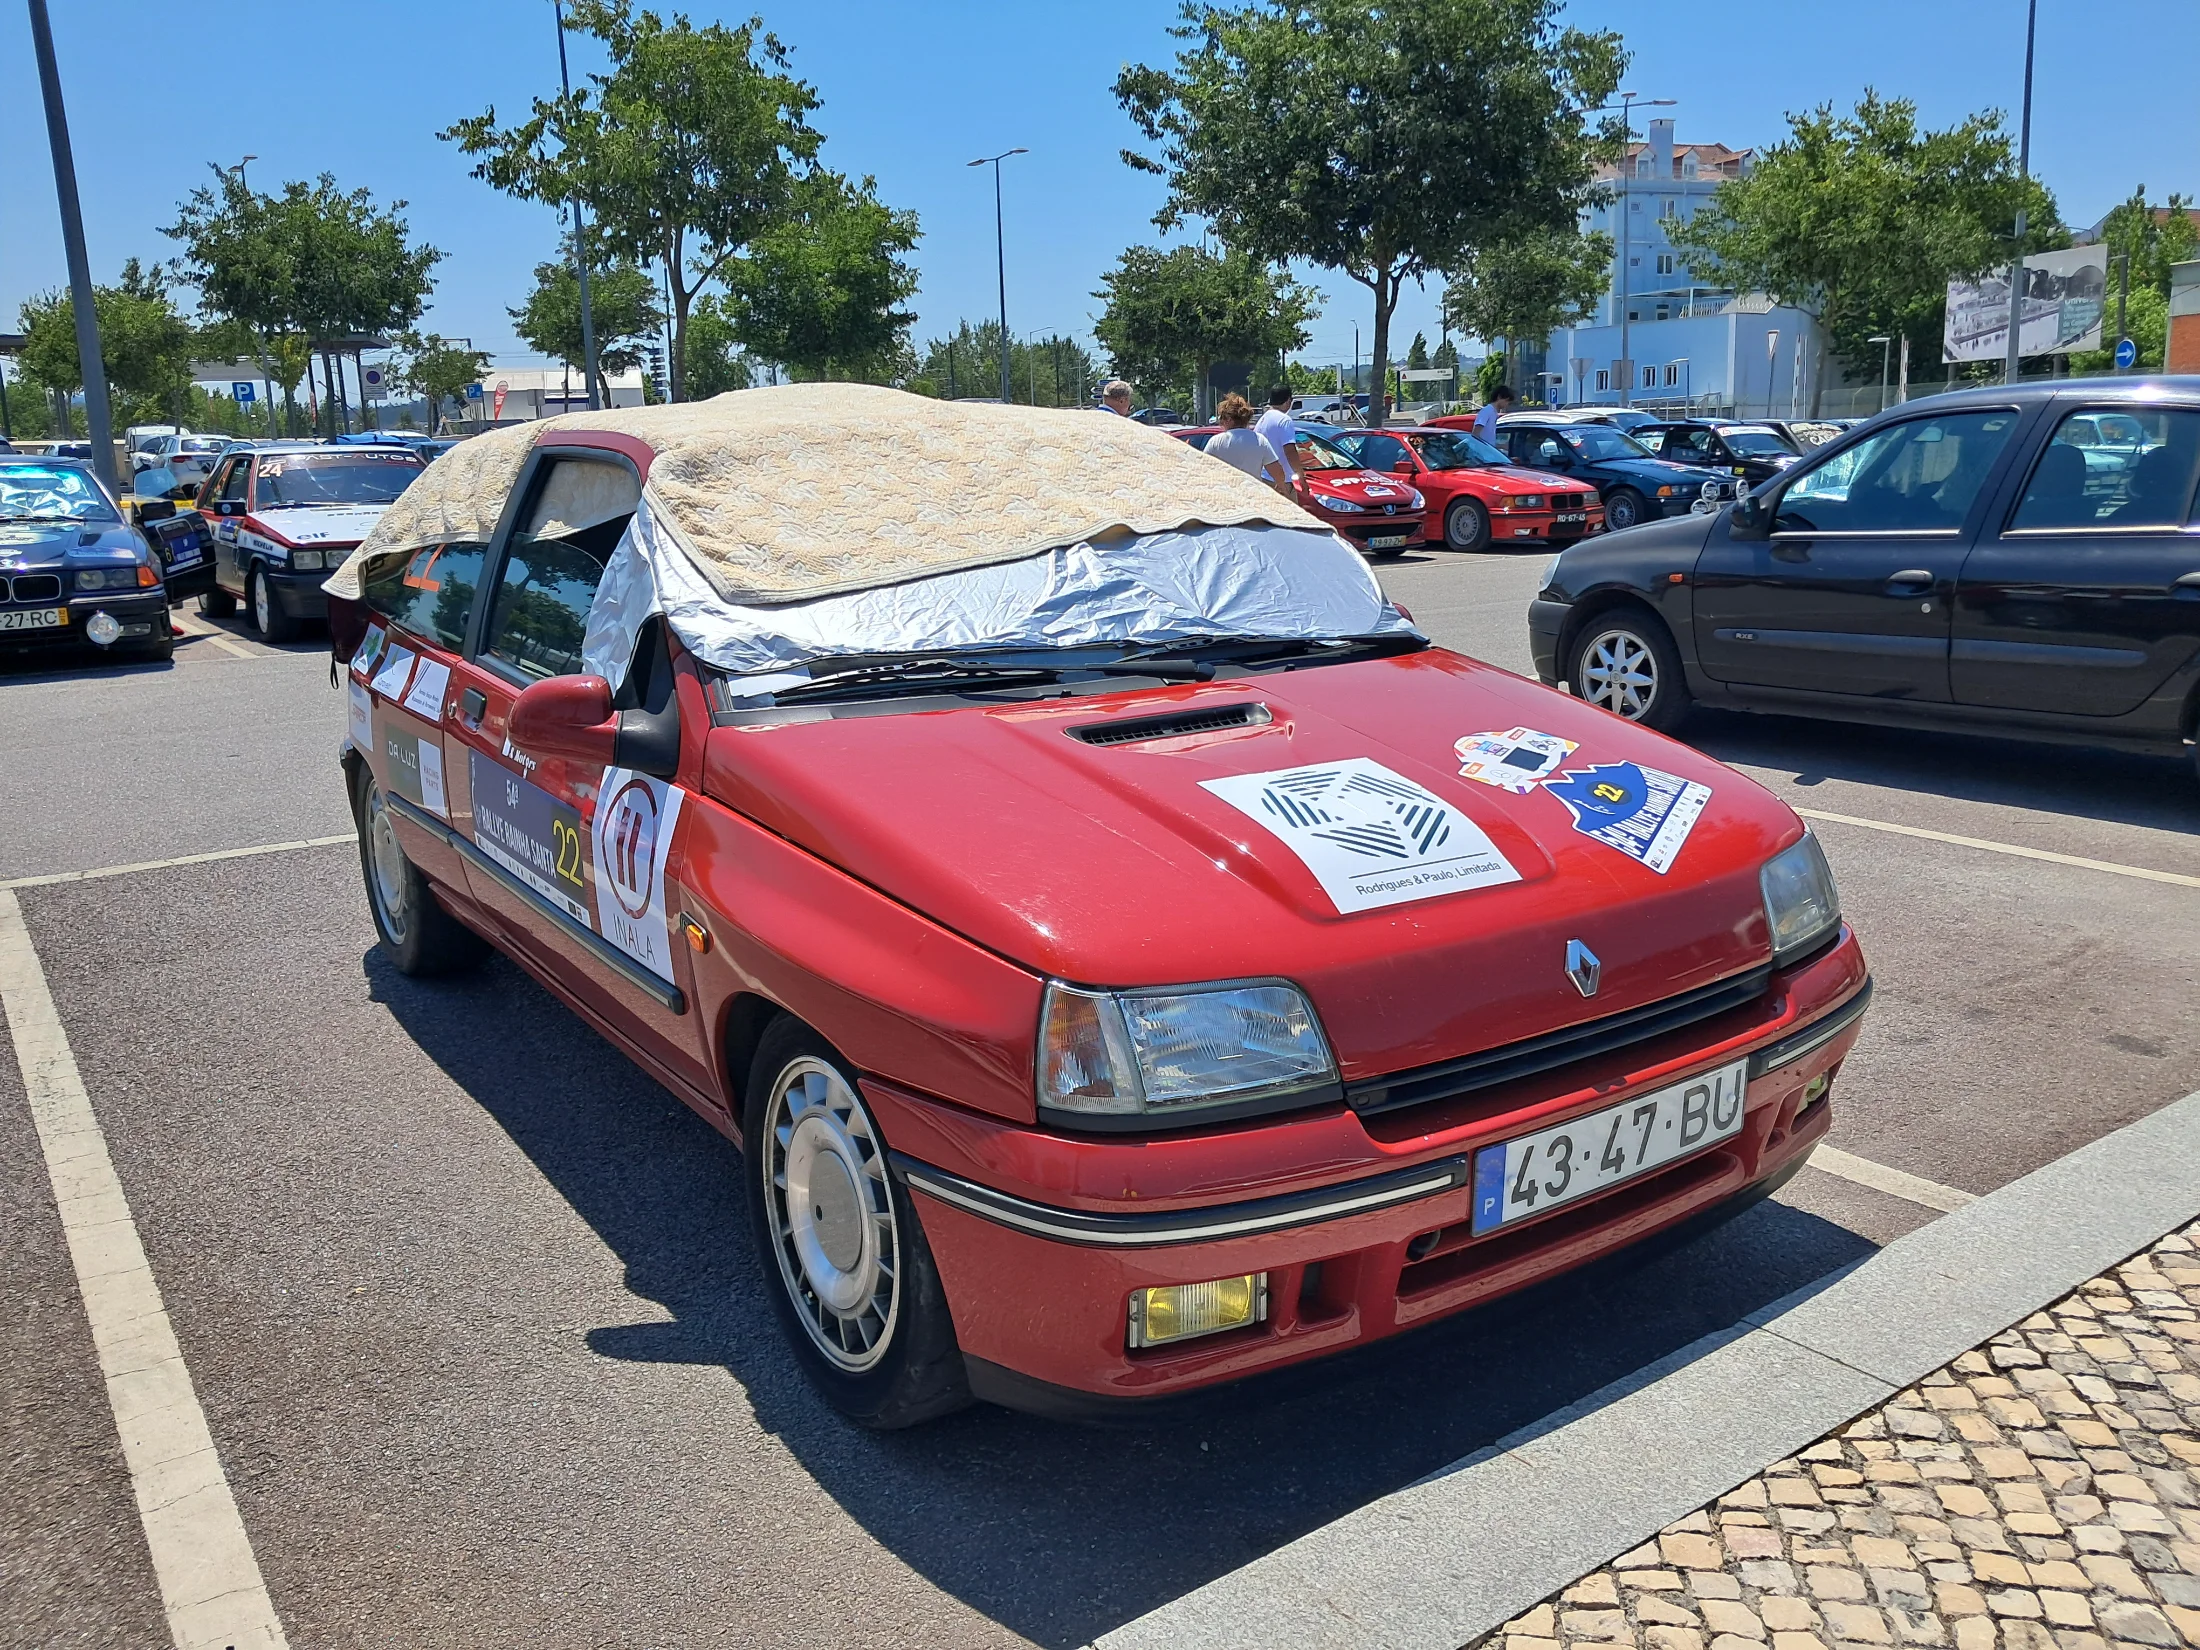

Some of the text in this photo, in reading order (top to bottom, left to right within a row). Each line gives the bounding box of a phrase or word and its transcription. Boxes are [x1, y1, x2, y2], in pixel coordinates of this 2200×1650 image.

[236, 384, 250, 400] P
[1551, 388, 1557, 398] P
[258, 463, 283, 478] 24
[296, 531, 330, 540] elf
[164, 547, 172, 563] 6
[400, 747, 417, 770] LUZ
[1593, 783, 1625, 802] 22
[481, 804, 506, 844] RALLYE
[504, 820, 533, 862] RAINHA
[530, 838, 557, 879] SANTA
[553, 819, 584, 888] 22
[1355, 861, 1502, 896] Rodrigues & Paulo, Limitada
[613, 913, 657, 966] INALA
[1483, 1197, 1496, 1216] P
